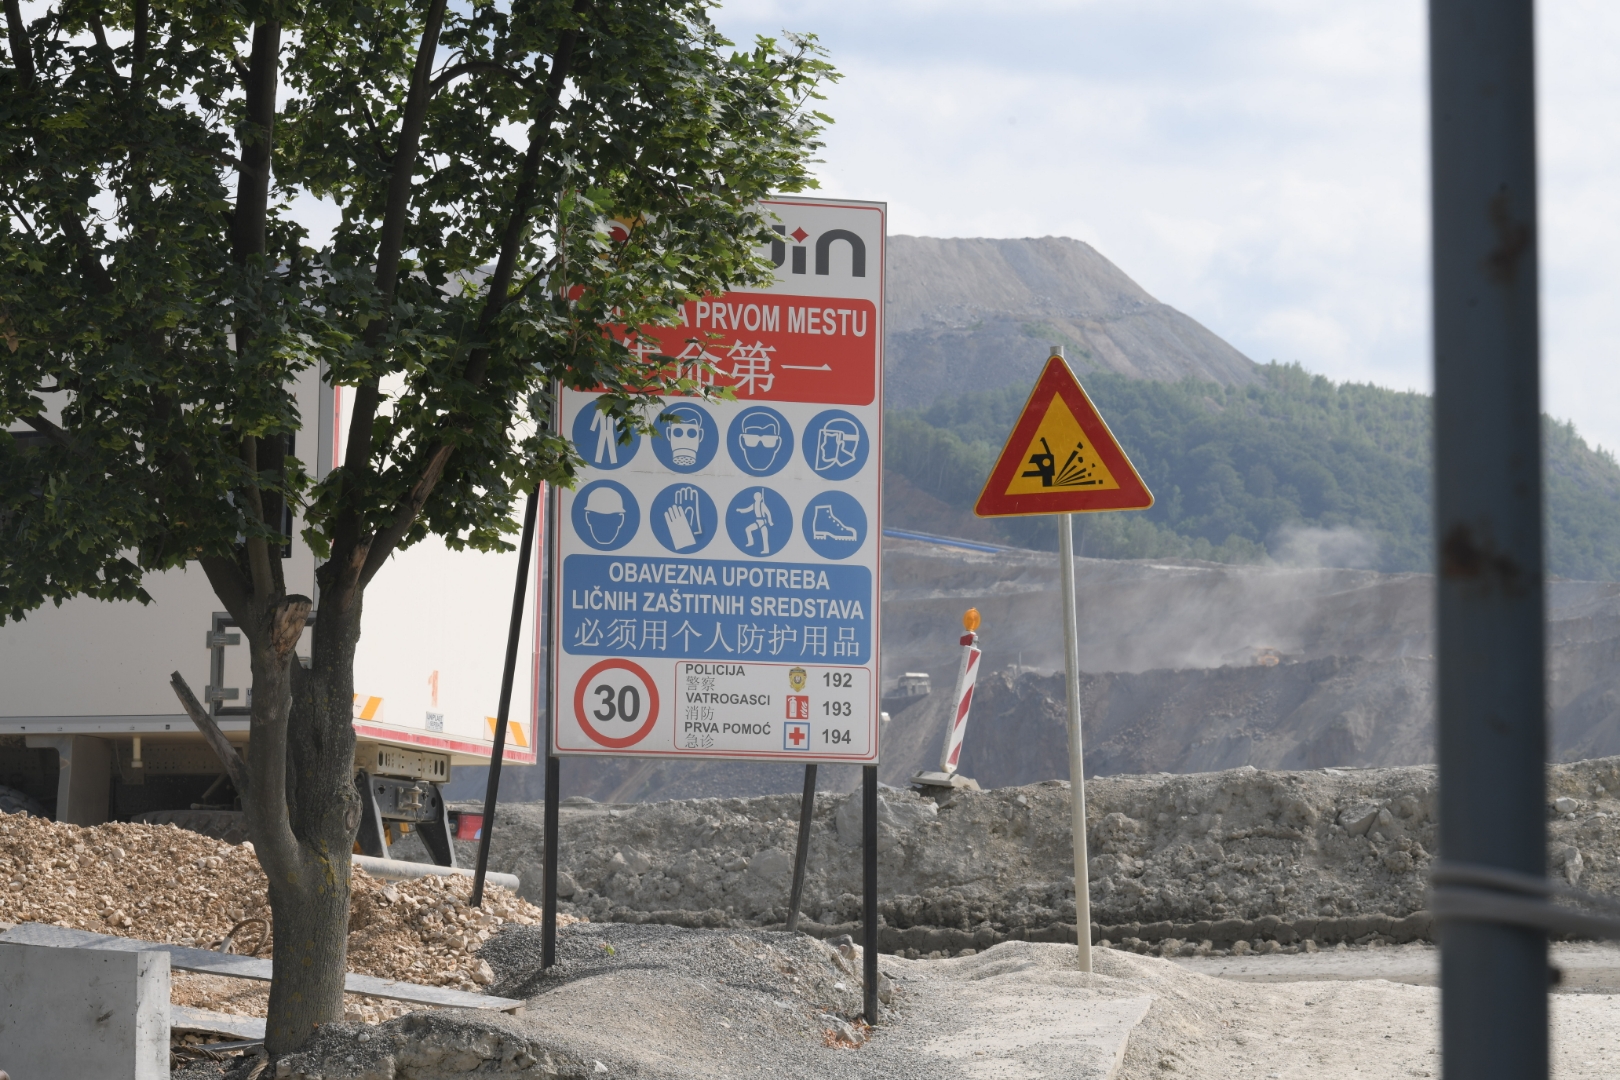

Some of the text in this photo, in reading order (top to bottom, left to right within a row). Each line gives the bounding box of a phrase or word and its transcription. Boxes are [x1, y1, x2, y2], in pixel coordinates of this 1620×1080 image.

[695, 301, 780, 332] PRVOM
[787, 306, 867, 338] MESTU
[609, 562, 830, 590] OBAVEZNA UPOTREBA
[572, 585, 864, 620] LIČNIH ZAŠTITNIH SREDSTAVA
[573, 617, 860, 657] 必须用个人防护用品
[685, 663, 746, 676] POLICIJA
[686, 675, 715, 692] 警察
[822, 672, 853, 688] 192
[593, 684, 640, 722] 30
[685, 692, 771, 706] VATROGASCI
[685, 705, 714, 721] 消防
[822, 701, 852, 717] 193
[684, 721, 771, 735] PRVA POMOĆ
[685, 733, 714, 749] 急诊
[821, 729, 852, 745] 194
